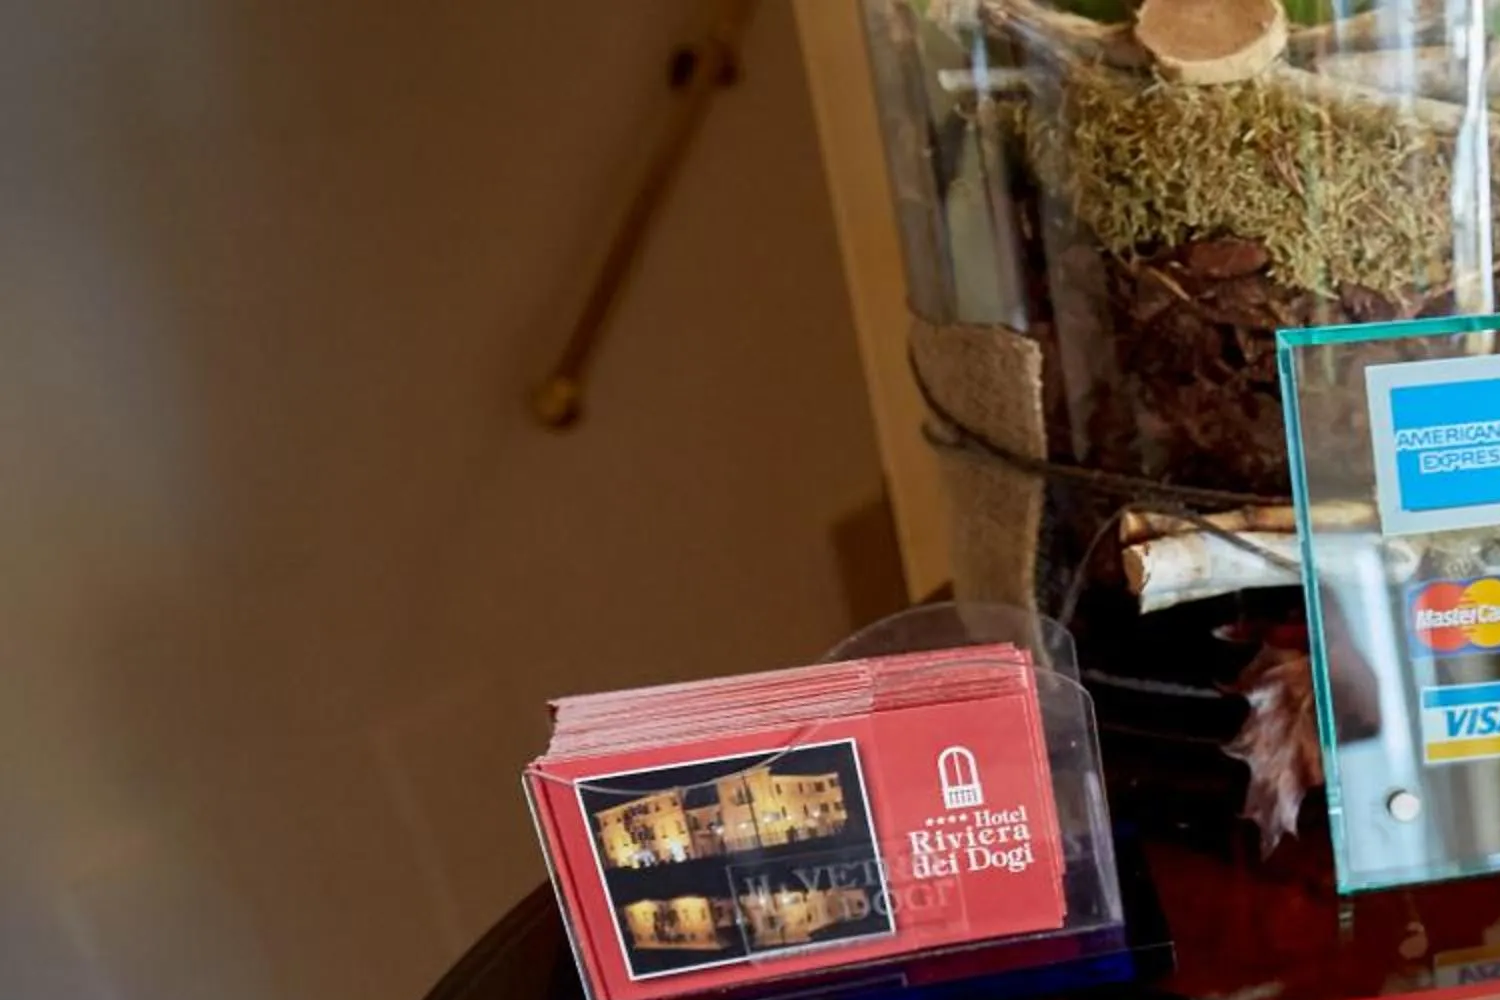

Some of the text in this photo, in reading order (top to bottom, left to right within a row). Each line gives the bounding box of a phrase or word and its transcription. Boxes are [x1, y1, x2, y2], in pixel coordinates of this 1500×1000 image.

[973, 805, 1029, 830] Hotel
[908, 822, 1032, 854] Riviera
[911, 844, 1035, 880] dei Dogi
